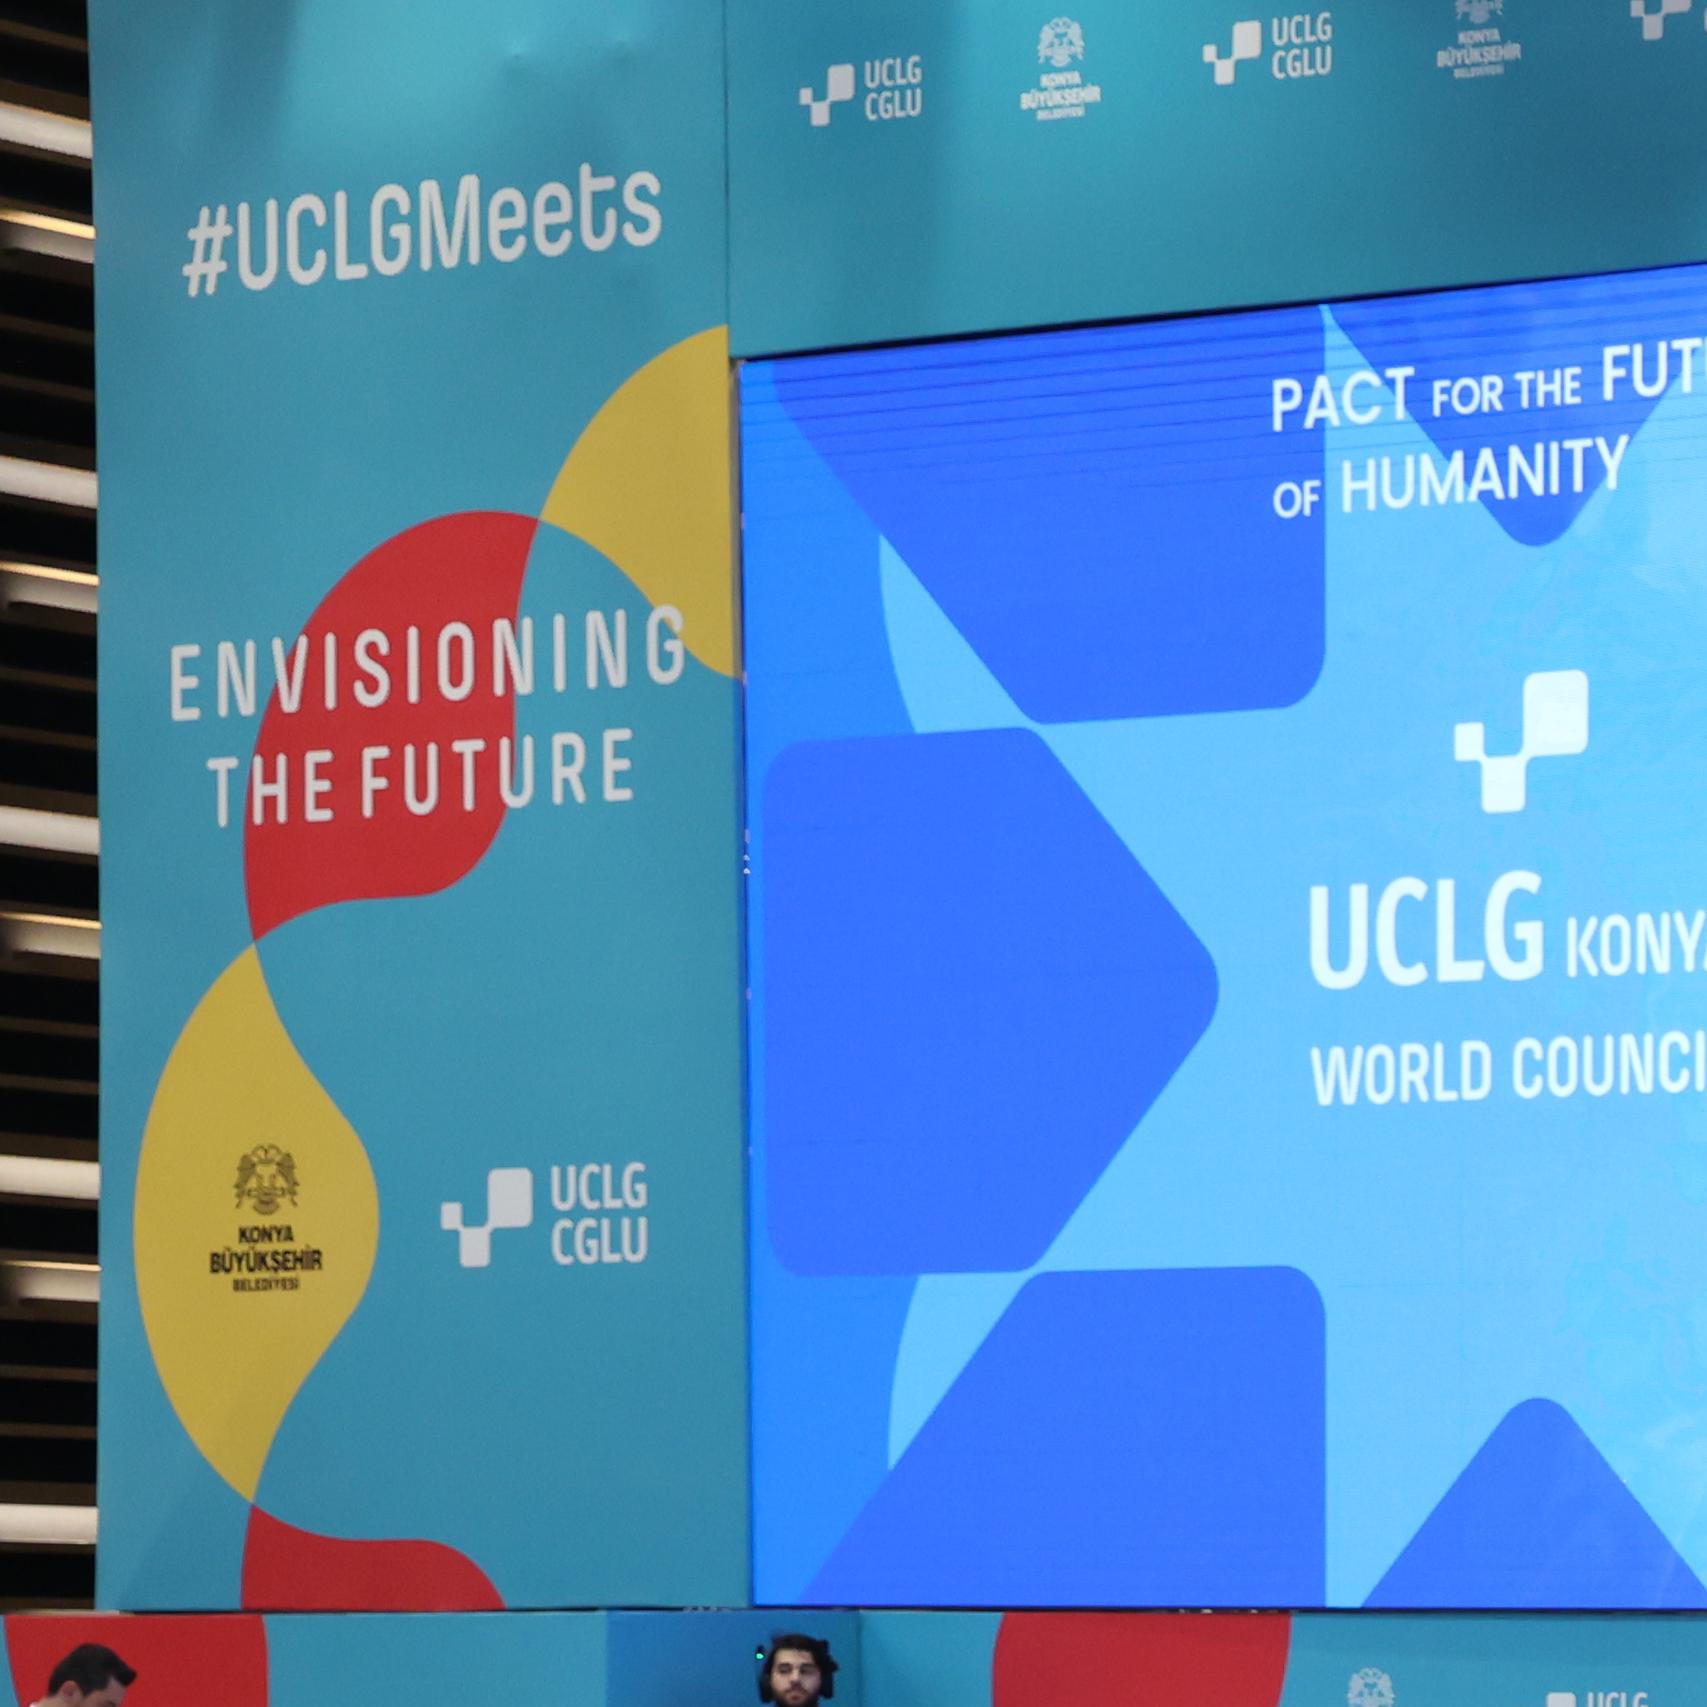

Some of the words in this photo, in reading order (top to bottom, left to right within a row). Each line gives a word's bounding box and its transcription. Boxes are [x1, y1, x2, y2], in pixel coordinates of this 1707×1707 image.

[1272, 12, 1332, 46] UCLG
[865, 55, 922, 89] UCLG
[1272, 46, 1331, 79] CGLU
[865, 88, 922, 120] CGLU
[182, 163, 661, 297] #UCLGMeets
[1274, 367, 1414, 431] PACT
[1433, 375, 1503, 417] FOR
[1514, 367, 1582, 408] THE
[1273, 480, 1321, 518] OF
[1342, 435, 1629, 513] HUMANITY
[171, 600, 689, 726] ENVISIONING
[207, 750, 336, 831] THE
[359, 724, 633, 821] FUTURE
[1310, 870, 1543, 989] UCLG
[1311, 1040, 1492, 1106] WORLD
[551, 1162, 647, 1211] UCLG
[239, 1225, 294, 1245] KONYA
[552, 1217, 648, 1265] CGLU
[210, 1246, 322, 1274] BÜYÜKŞEHİR
